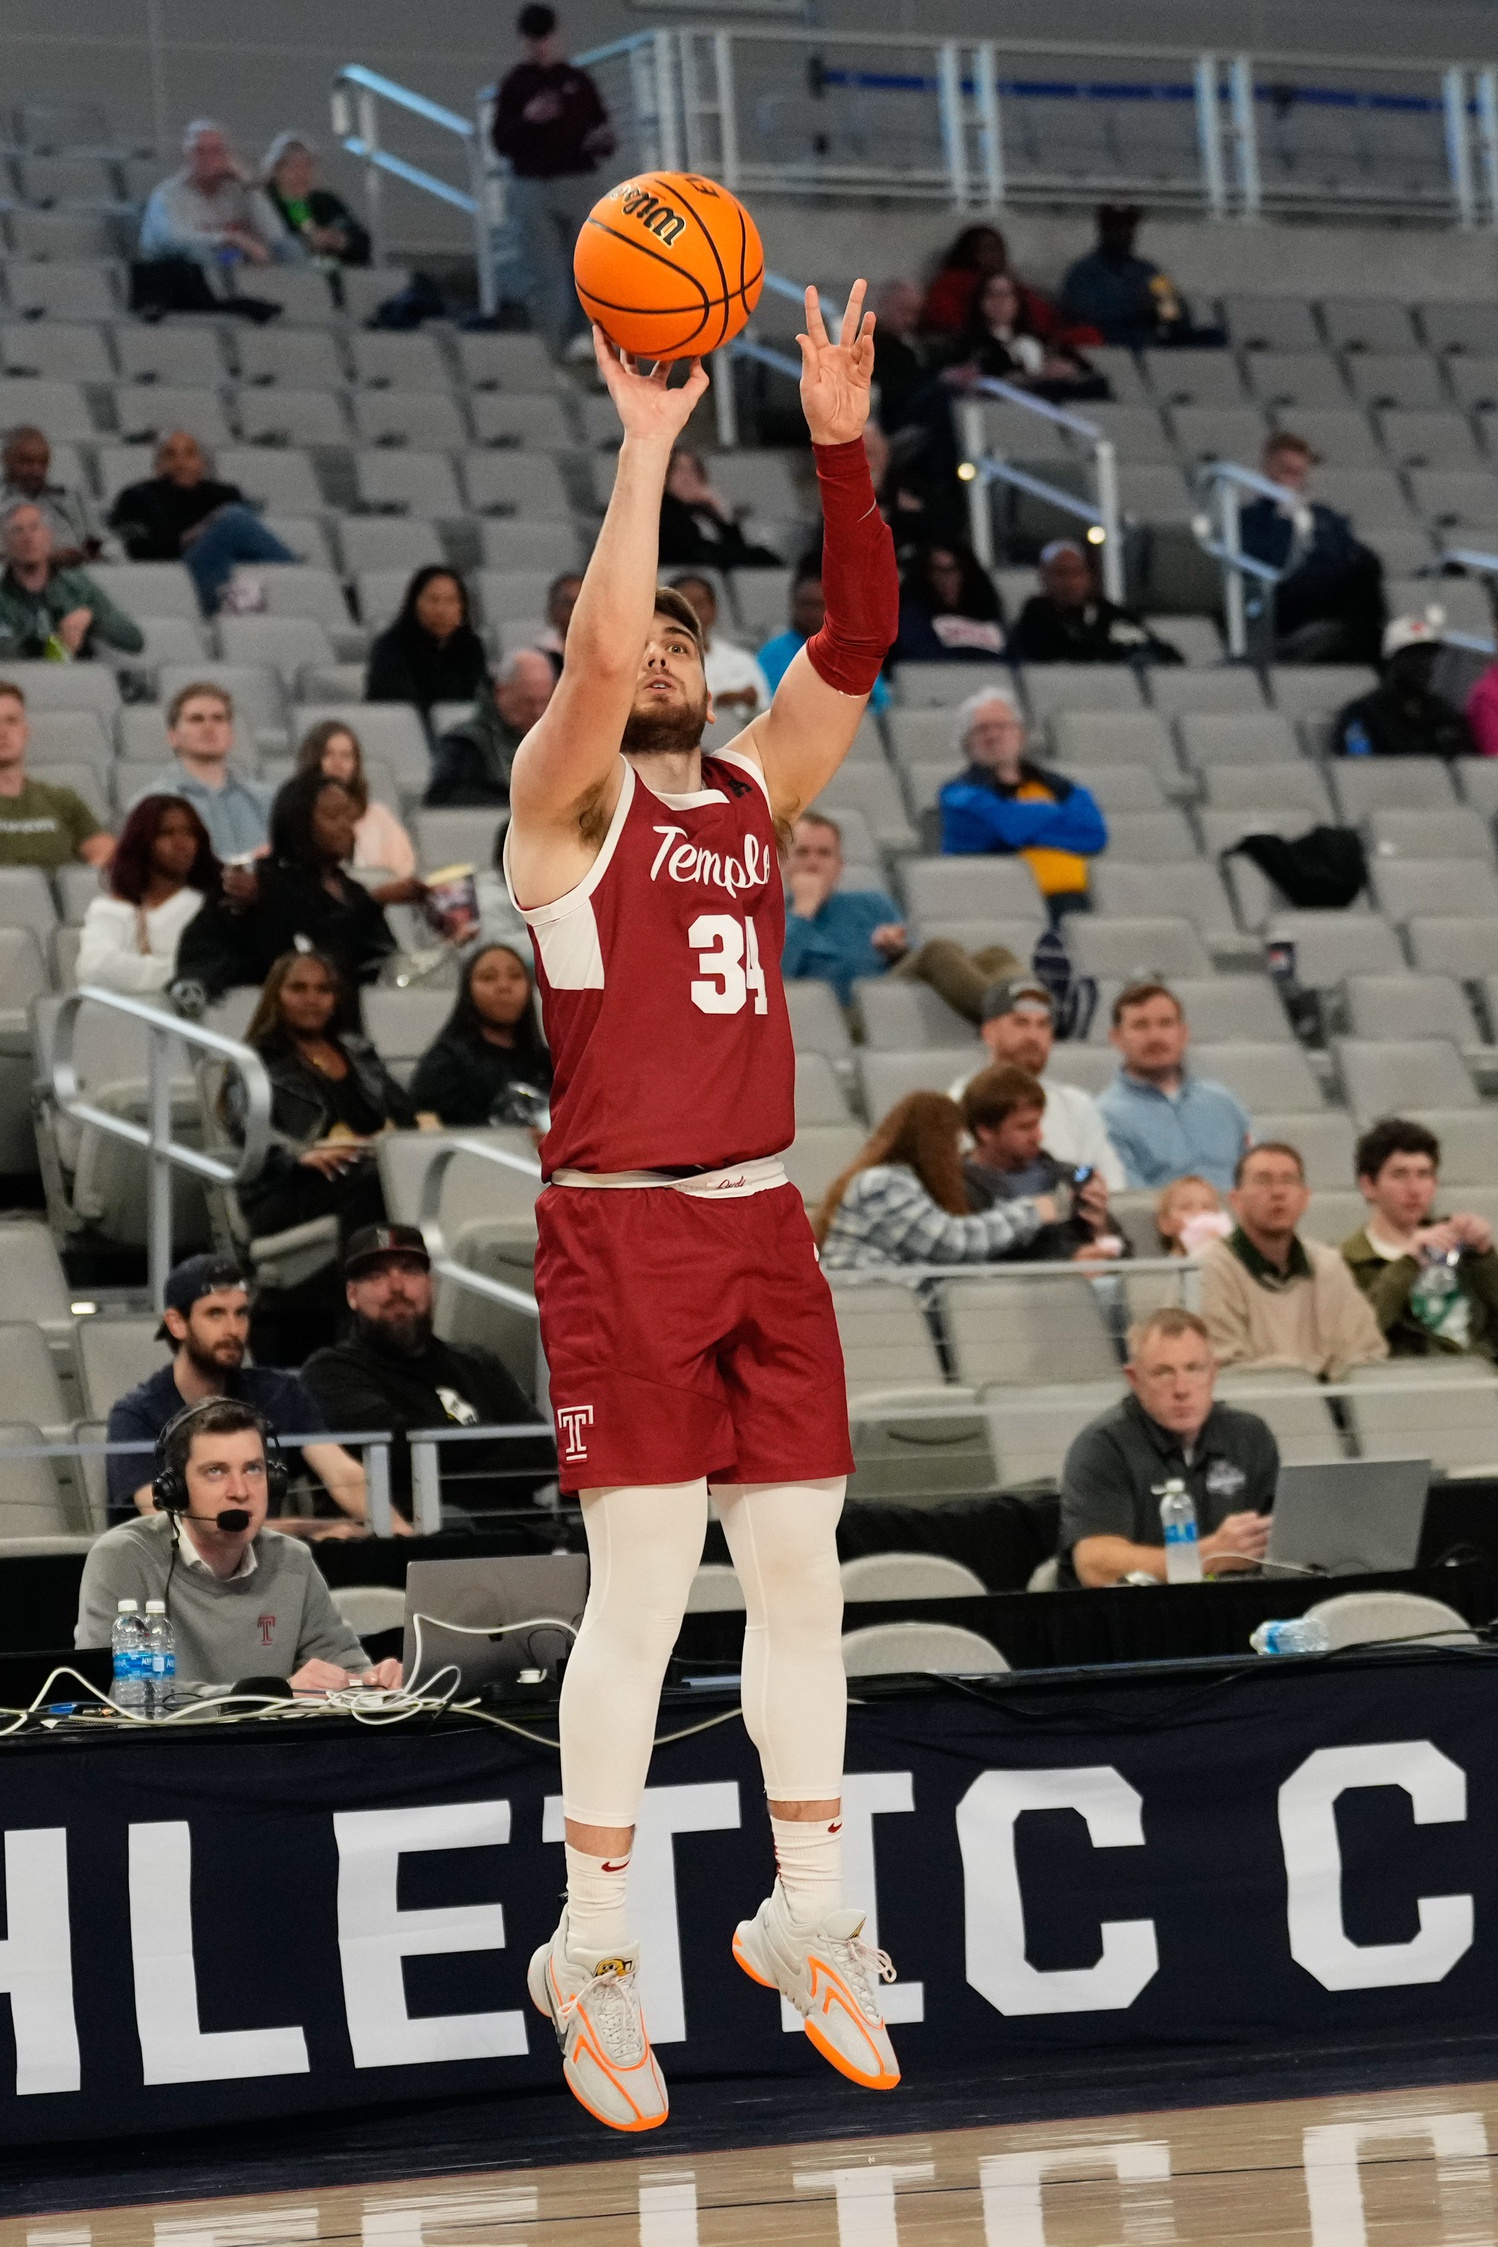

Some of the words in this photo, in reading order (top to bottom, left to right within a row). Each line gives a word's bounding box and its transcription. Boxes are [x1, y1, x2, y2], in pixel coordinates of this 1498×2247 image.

[607, 182, 687, 250] Wils
[688, 913, 768, 1015] 34
[557, 1404, 594, 1462] T
[257, 1614, 276, 1647] T
[1278, 1740, 1476, 1992] C
